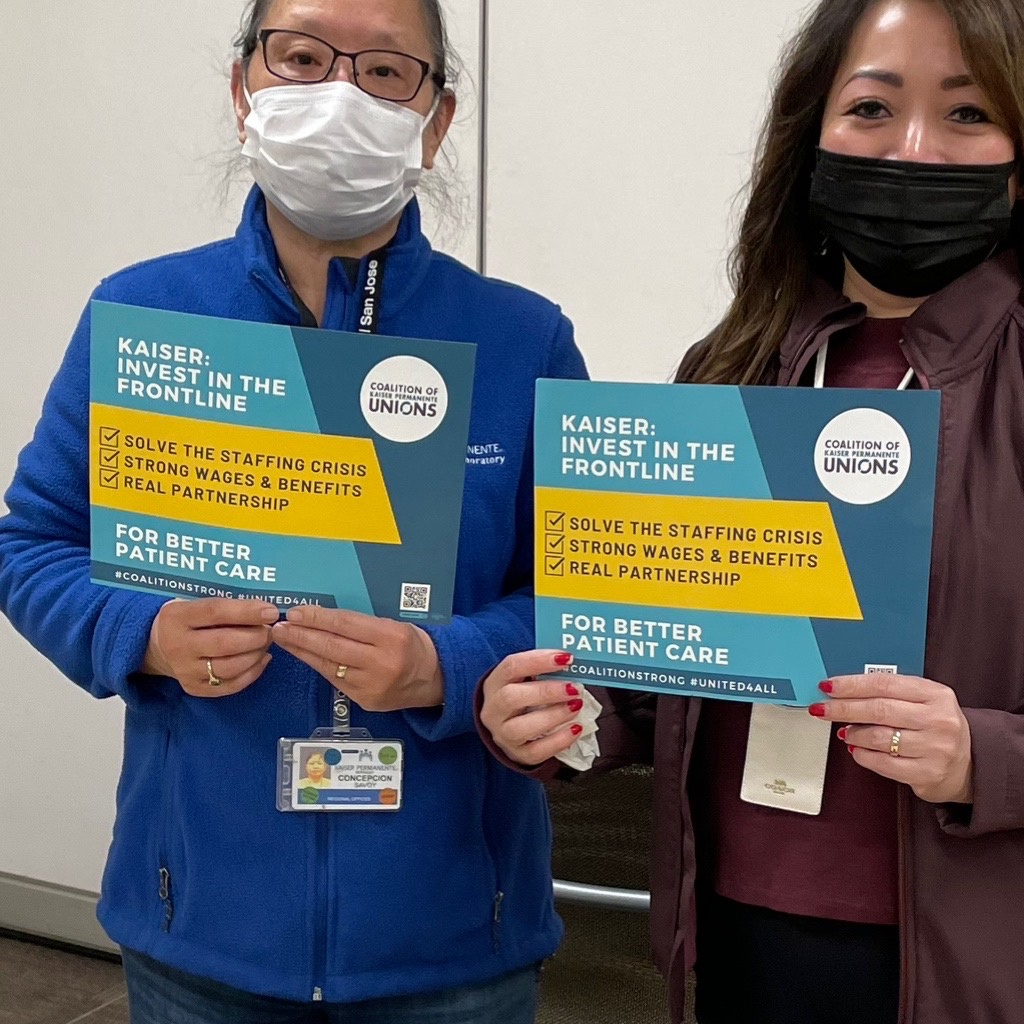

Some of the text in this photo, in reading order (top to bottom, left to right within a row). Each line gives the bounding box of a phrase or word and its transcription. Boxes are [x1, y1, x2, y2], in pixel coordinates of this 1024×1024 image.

[360, 260, 378, 326] San Jose
[117, 339, 210, 365] KAISER:
[117, 359, 286, 395] INVEST IN THE
[369, 381, 438, 395] COALITION OF
[117, 380, 247, 410] FRONTLINE
[368, 397, 438, 418] UNIONS
[394, 392, 438, 402] PERMANENTE
[561, 416, 655, 435] KAISER:
[124, 435, 366, 478] SOLVE THE STAFFING CRISIS
[561, 437, 735, 460] INVEST IN THE
[824, 439, 900, 450] COALITION OF
[561, 458, 695, 481] FRONTLINE
[823, 457, 899, 475] UNIONS
[115, 524, 250, 559] FOR BETTER
[569, 517, 822, 545] SOLVE THE STAFFING CRISIS
[114, 544, 276, 582] PATIENT CARE
[569, 539, 818, 568] STRONG WAGES & BENEFITS
[569, 561, 740, 586] REAL PARTNERSHIP
[561, 614, 702, 641] FOR BETTER
[561, 634, 728, 664] PATIENT CARE
[690, 677, 777, 694] #UNITED4ALL
